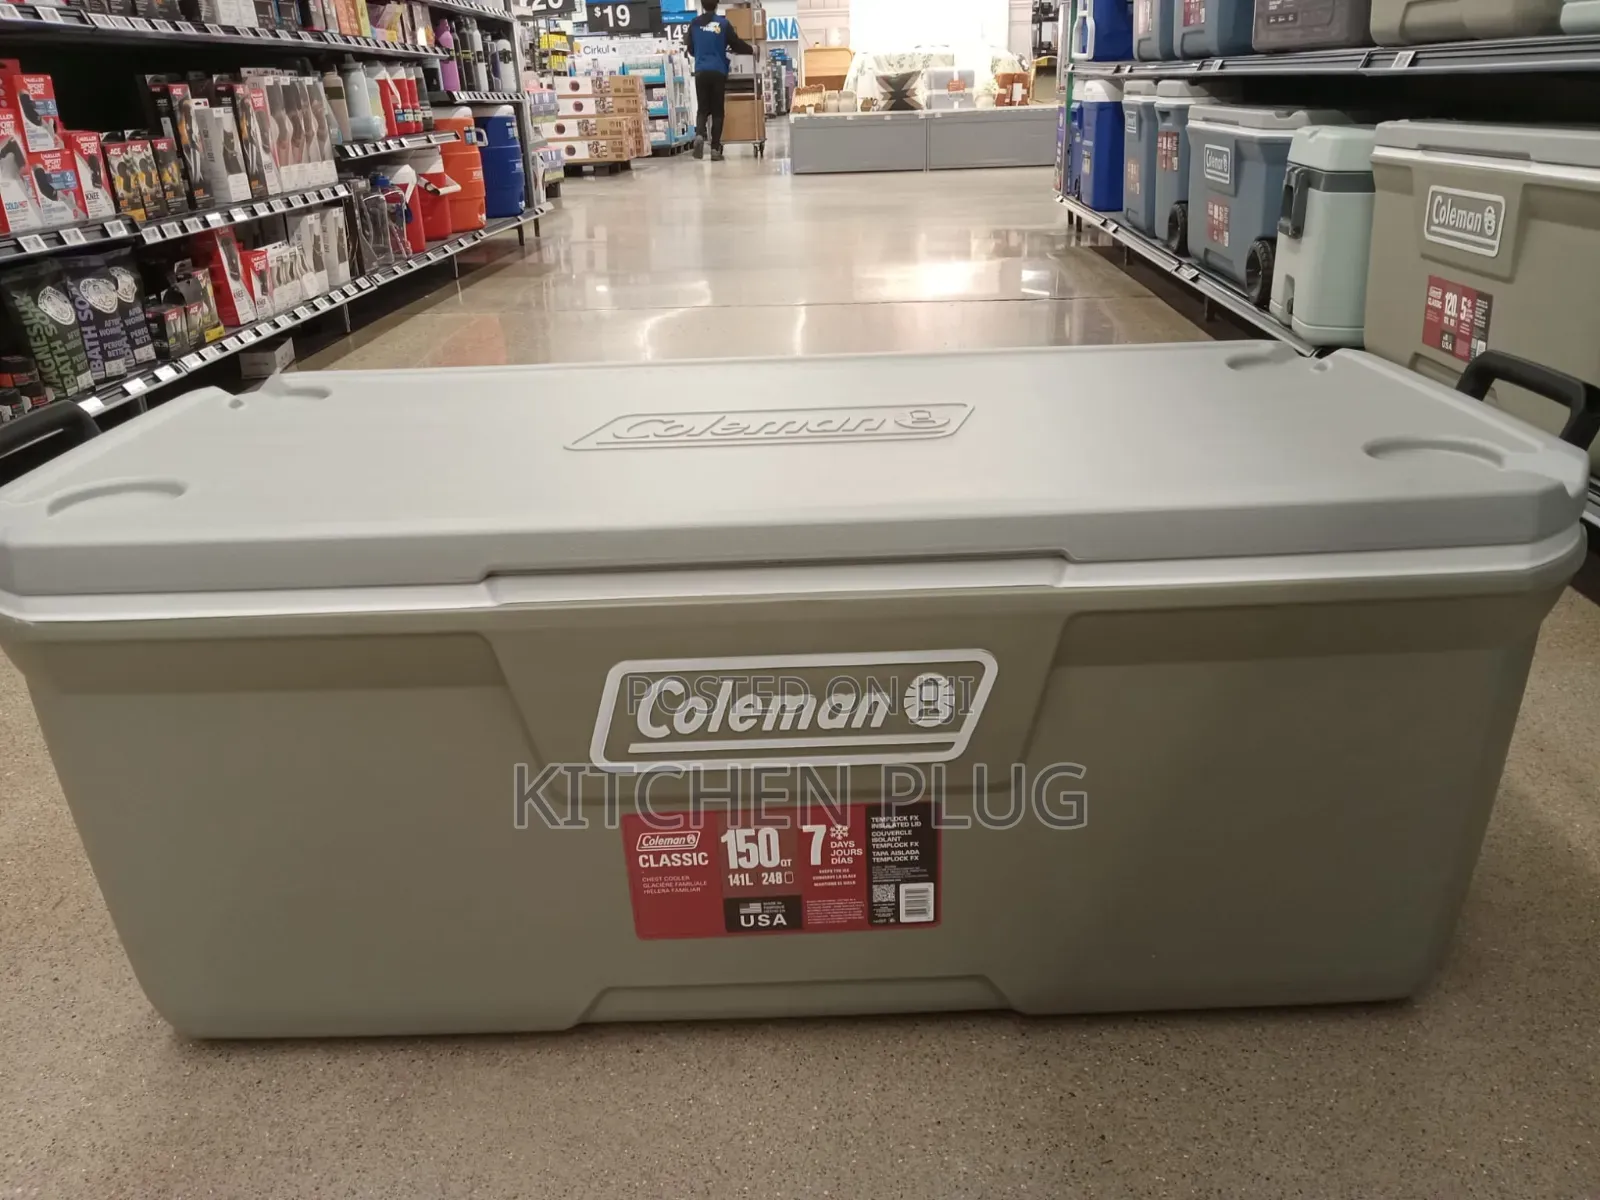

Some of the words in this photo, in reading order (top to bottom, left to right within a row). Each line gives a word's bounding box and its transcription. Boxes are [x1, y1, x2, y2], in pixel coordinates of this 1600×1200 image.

[583, 45, 610, 54] Cirkul
[172, 87, 183, 95] ACE
[131, 144, 143, 153] ACE
[157, 141, 168, 150] ACE
[110, 147, 122, 156] ACE
[85, 192, 100, 200] KNEE
[1433, 195, 1482, 232] Coleman
[1444, 291, 1458, 316] 120
[1460, 296, 1468, 320] 5
[167, 312, 178, 321] ACE
[189, 306, 199, 316] ACE
[81, 325, 105, 373] BATH
[1441, 340, 1453, 351] USA
[50, 340, 79, 389] BATH
[613, 415, 886, 438] Coleman
[637, 678, 891, 738] Coleman
[871, 815, 908, 823] TEMPLOCK
[641, 835, 686, 847] Coleman
[802, 824, 827, 866] 7
[830, 840, 855, 849] DAYS
[721, 827, 780, 869] 150
[830, 849, 863, 857] JOURS
[638, 852, 709, 868] CLASSIC
[831, 857, 854, 865] DÍAS
[728, 872, 754, 887] 141L
[762, 872, 783, 885] 248
[740, 914, 788, 928] USA
